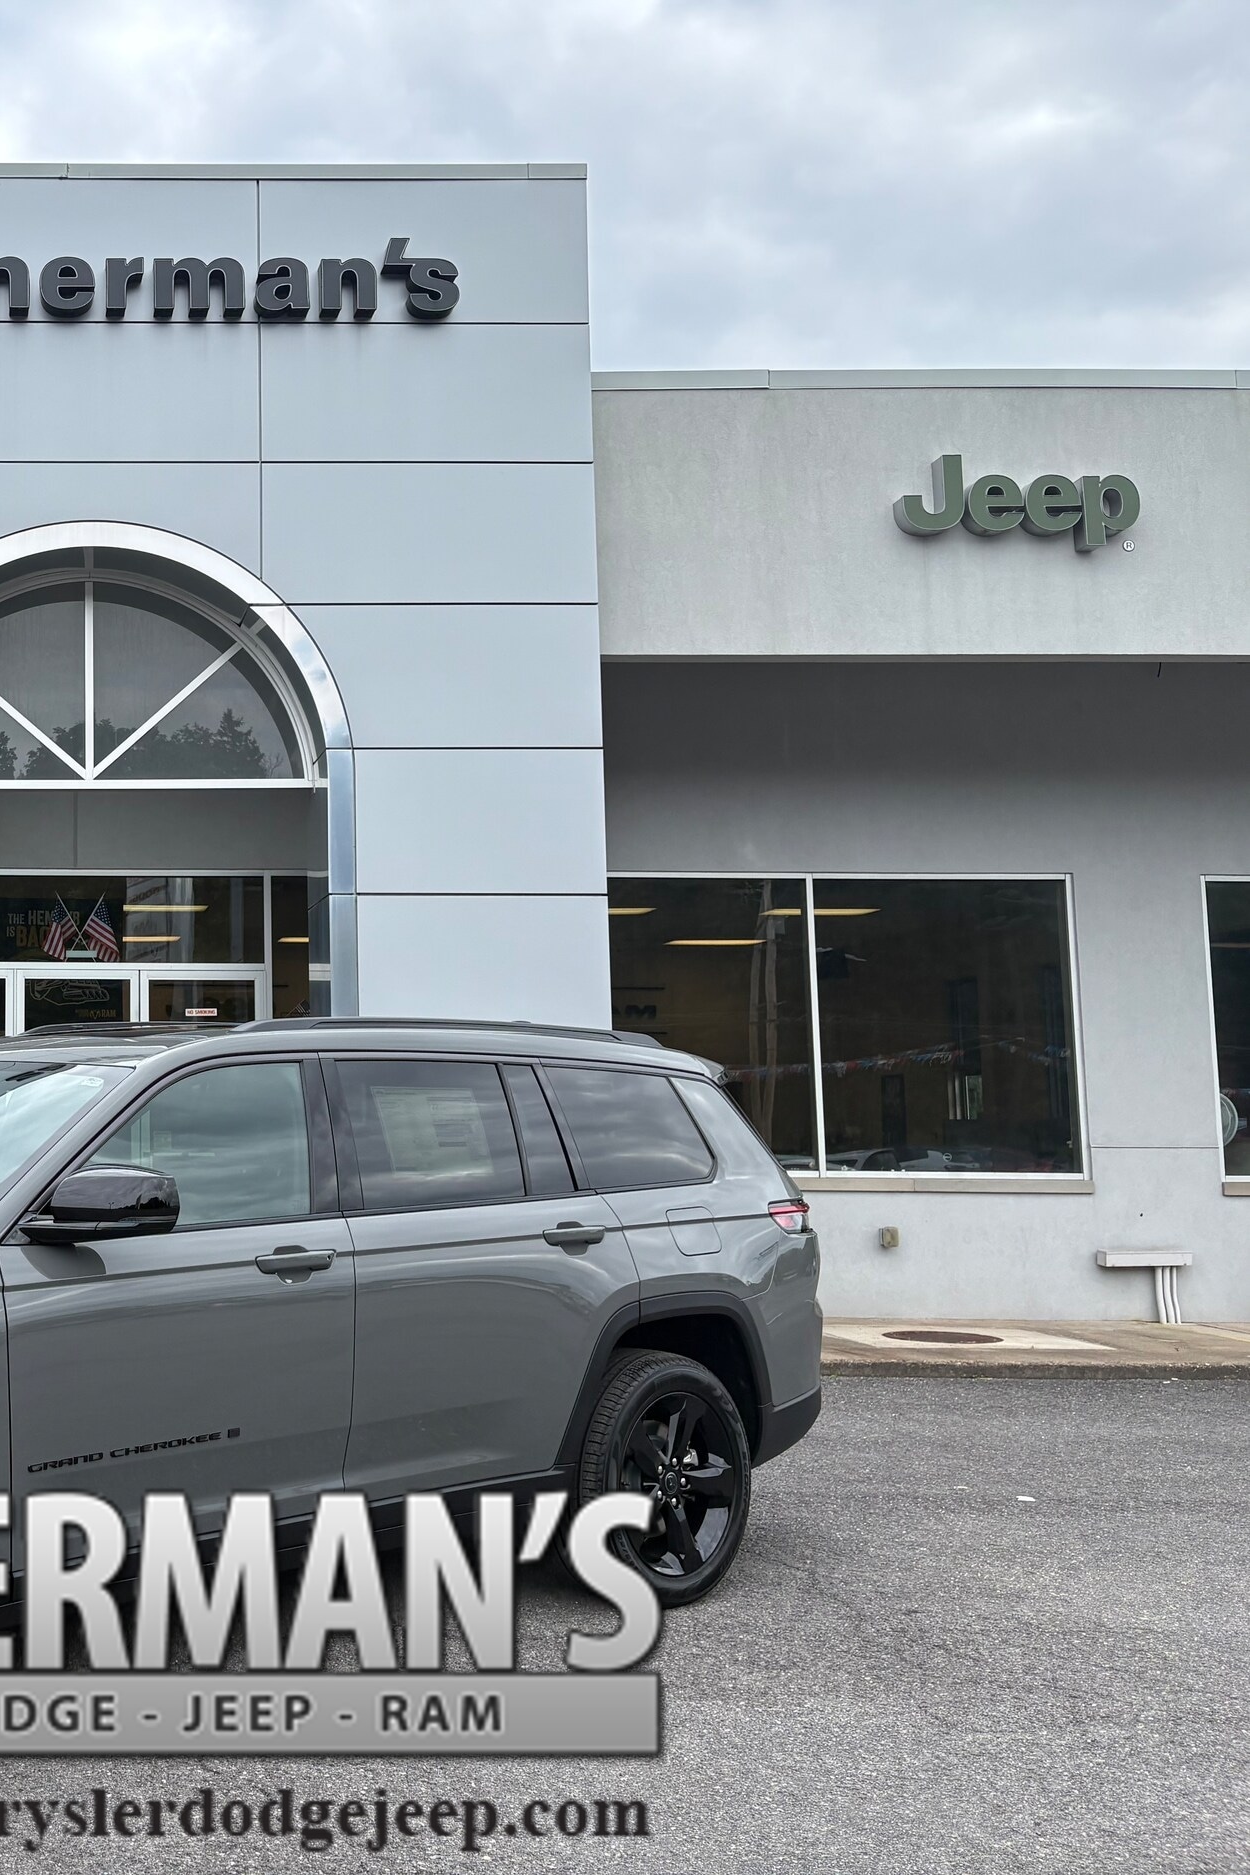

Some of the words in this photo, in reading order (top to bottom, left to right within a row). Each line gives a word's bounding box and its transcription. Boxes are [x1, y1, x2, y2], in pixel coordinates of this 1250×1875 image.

[893, 454, 1141, 552] Jeep
[7, 912, 26, 926] THE
[6, 926, 16, 937] IS
[16, 925, 49, 948] BAC
[101, 1009, 117, 1018] RAM
[27, 1452, 104, 1473] GRAND
[110, 1432, 222, 1458] CHEROKEE
